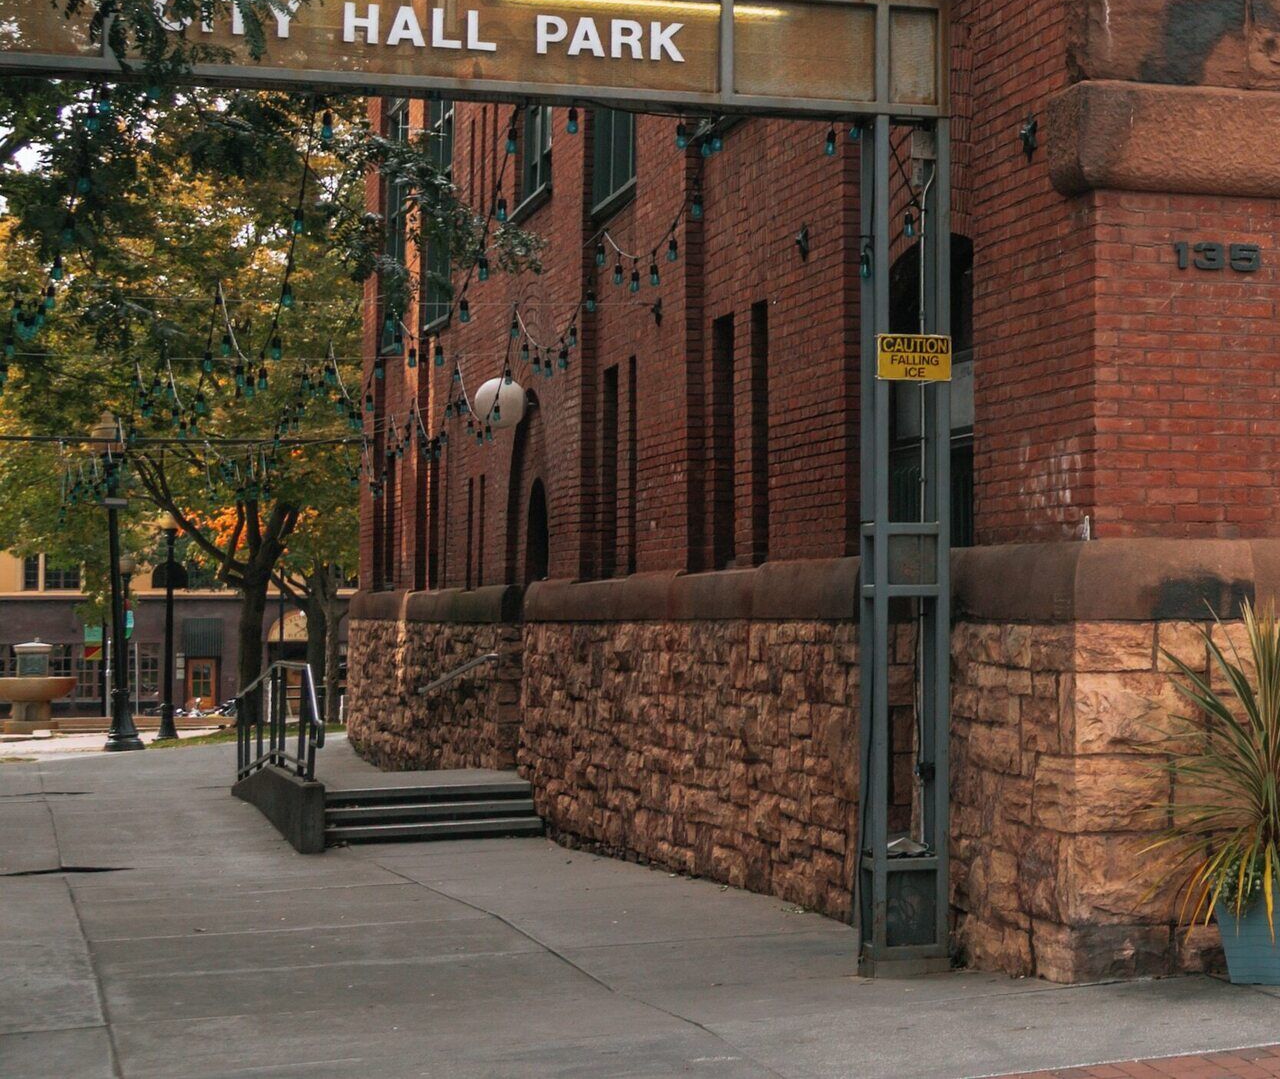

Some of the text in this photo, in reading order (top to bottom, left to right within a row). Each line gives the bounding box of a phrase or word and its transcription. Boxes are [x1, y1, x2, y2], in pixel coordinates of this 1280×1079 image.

[343, 1, 498, 52] HALL
[536, 14, 686, 63] PARK
[1174, 241, 1261, 271] 135
[882, 337, 948, 353] CAUTION
[891, 354, 940, 366] FALLING
[904, 367, 926, 378] ICE
